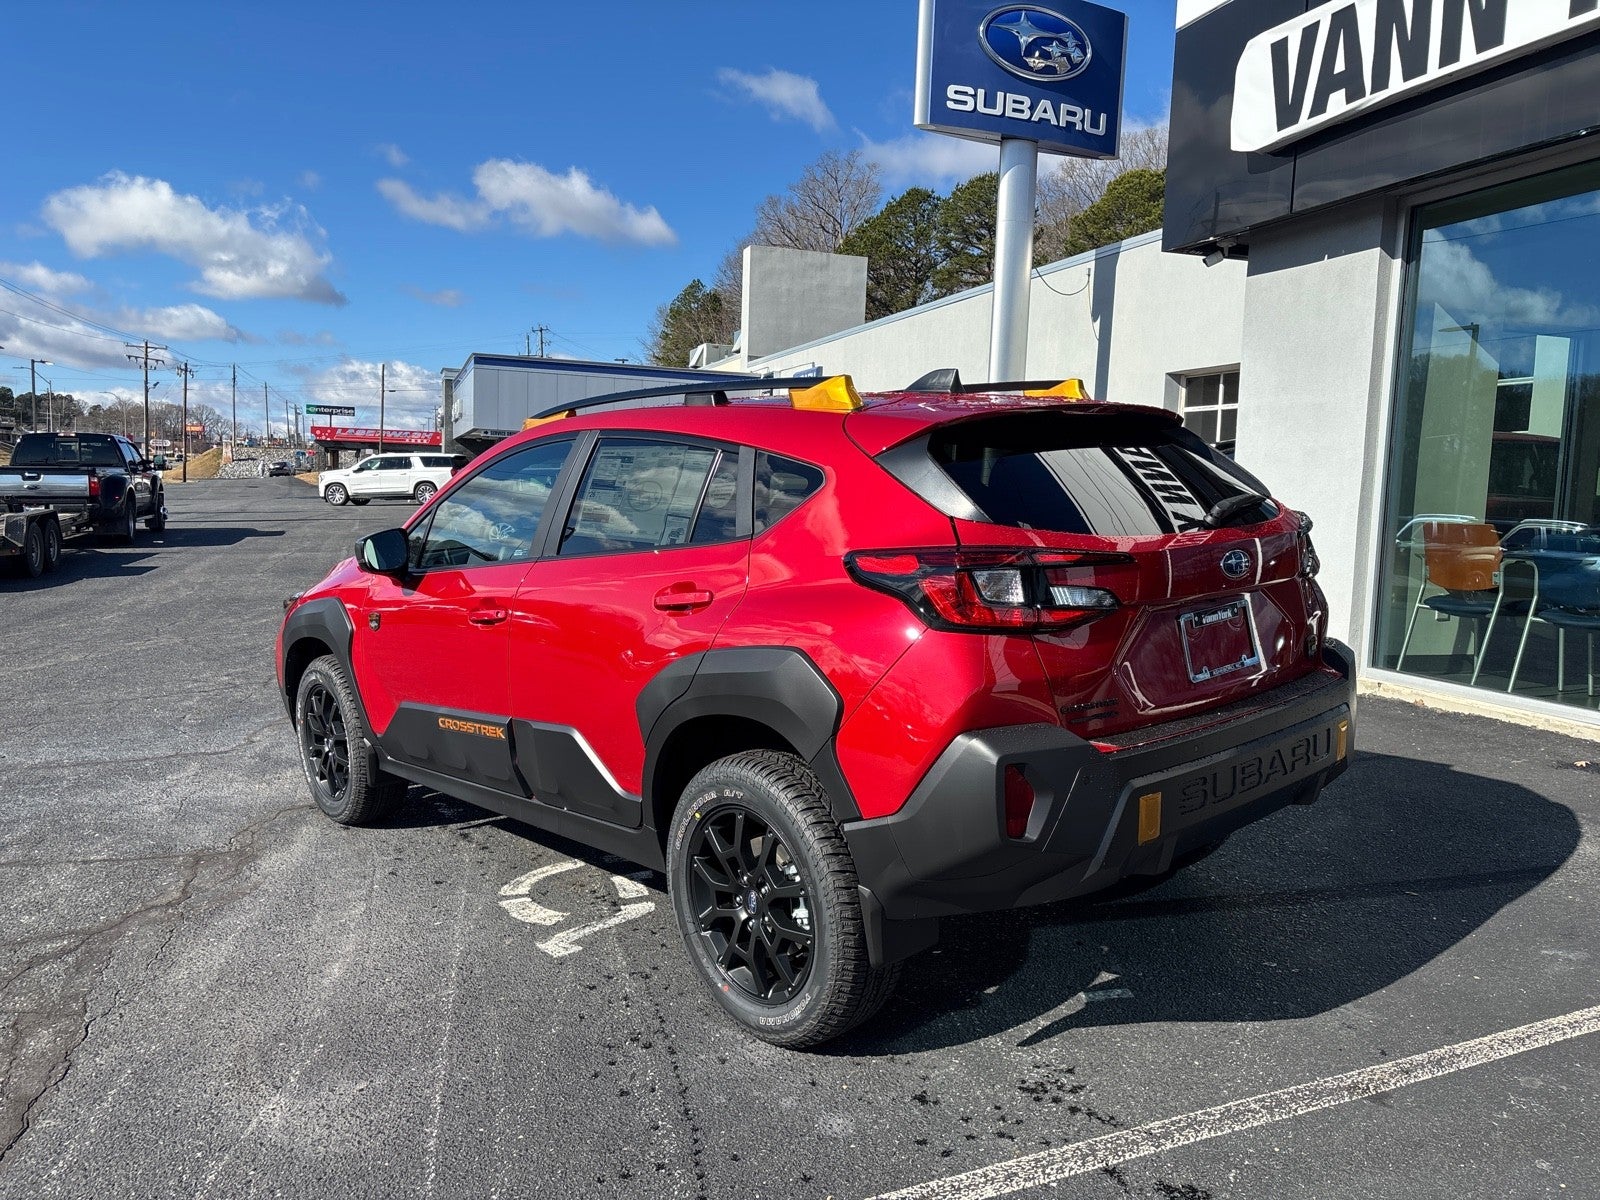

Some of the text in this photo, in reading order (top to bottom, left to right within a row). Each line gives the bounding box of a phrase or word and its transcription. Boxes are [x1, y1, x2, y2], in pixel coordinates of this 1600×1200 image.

[1270, 0, 1508, 132] VANN
[946, 84, 1107, 136] SUBARU
[308, 406, 354, 414] enterprise
[438, 717, 506, 739] CROSSTREK
[1178, 728, 1331, 816] SUBARU
[675, 791, 717, 849] GEOLANDAR
[760, 993, 811, 1026] YOKOHAMA
